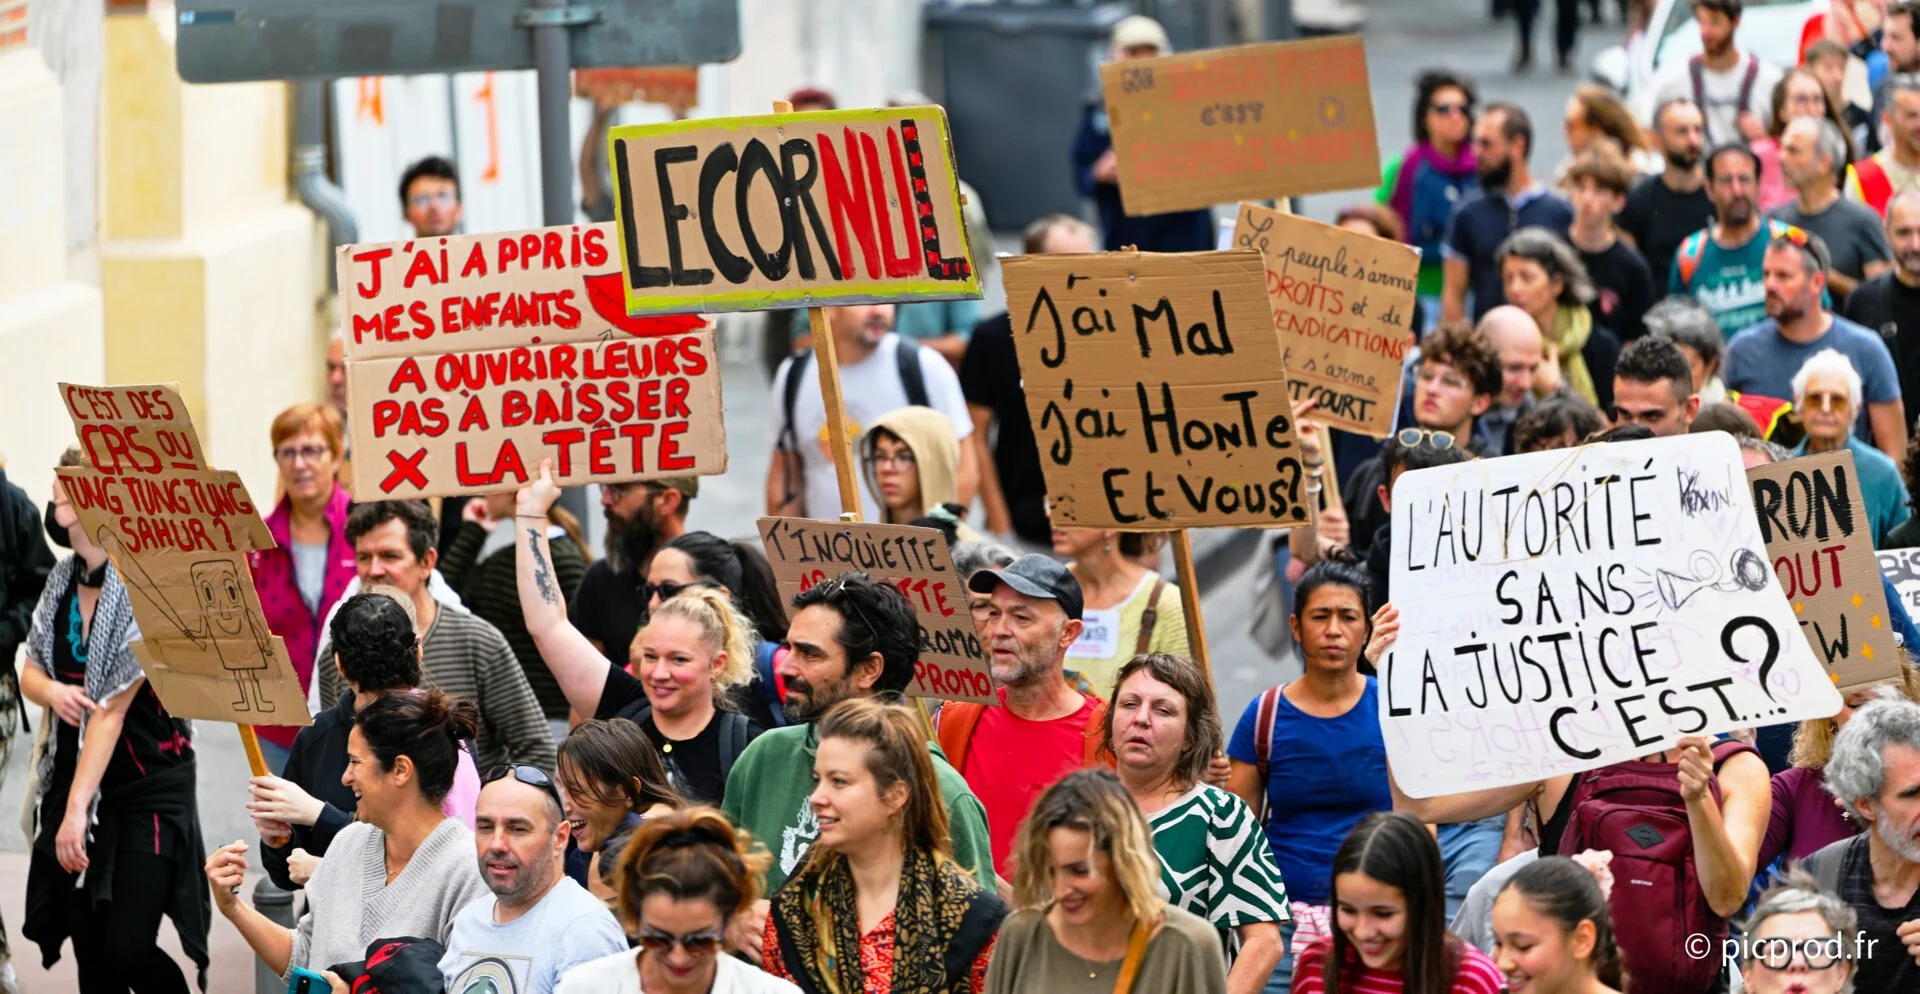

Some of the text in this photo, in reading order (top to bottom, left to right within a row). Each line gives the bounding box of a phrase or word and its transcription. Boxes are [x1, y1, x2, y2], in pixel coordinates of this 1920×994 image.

[614, 119, 972, 289] LECORNUL
[1239, 209, 1273, 253] Le
[1277, 247, 1348, 284] peuple
[353, 290, 581, 344] MES ENFANTS
[1132, 290, 1234, 358] Mal
[1273, 309, 1406, 360] ENDICATIONS
[1351, 296, 1367, 318] et
[1378, 304, 1401, 326] de
[583, 337, 708, 379] LEURS
[1302, 352, 1379, 392] s'arme
[67, 386, 174, 420] C'EST DES
[373, 398, 450, 438] PAS
[458, 390, 489, 432] À
[81, 424, 193, 475] CRS OU
[455, 439, 529, 487] LA
[543, 419, 696, 477] TÊTE
[1102, 468, 1173, 523] Et
[1496, 563, 1635, 625] SANS
[1771, 544, 1846, 600] OUT
[919, 626, 982, 659] ROMO
[914, 660, 991, 697] PROMO
[1388, 649, 1448, 717] LA
